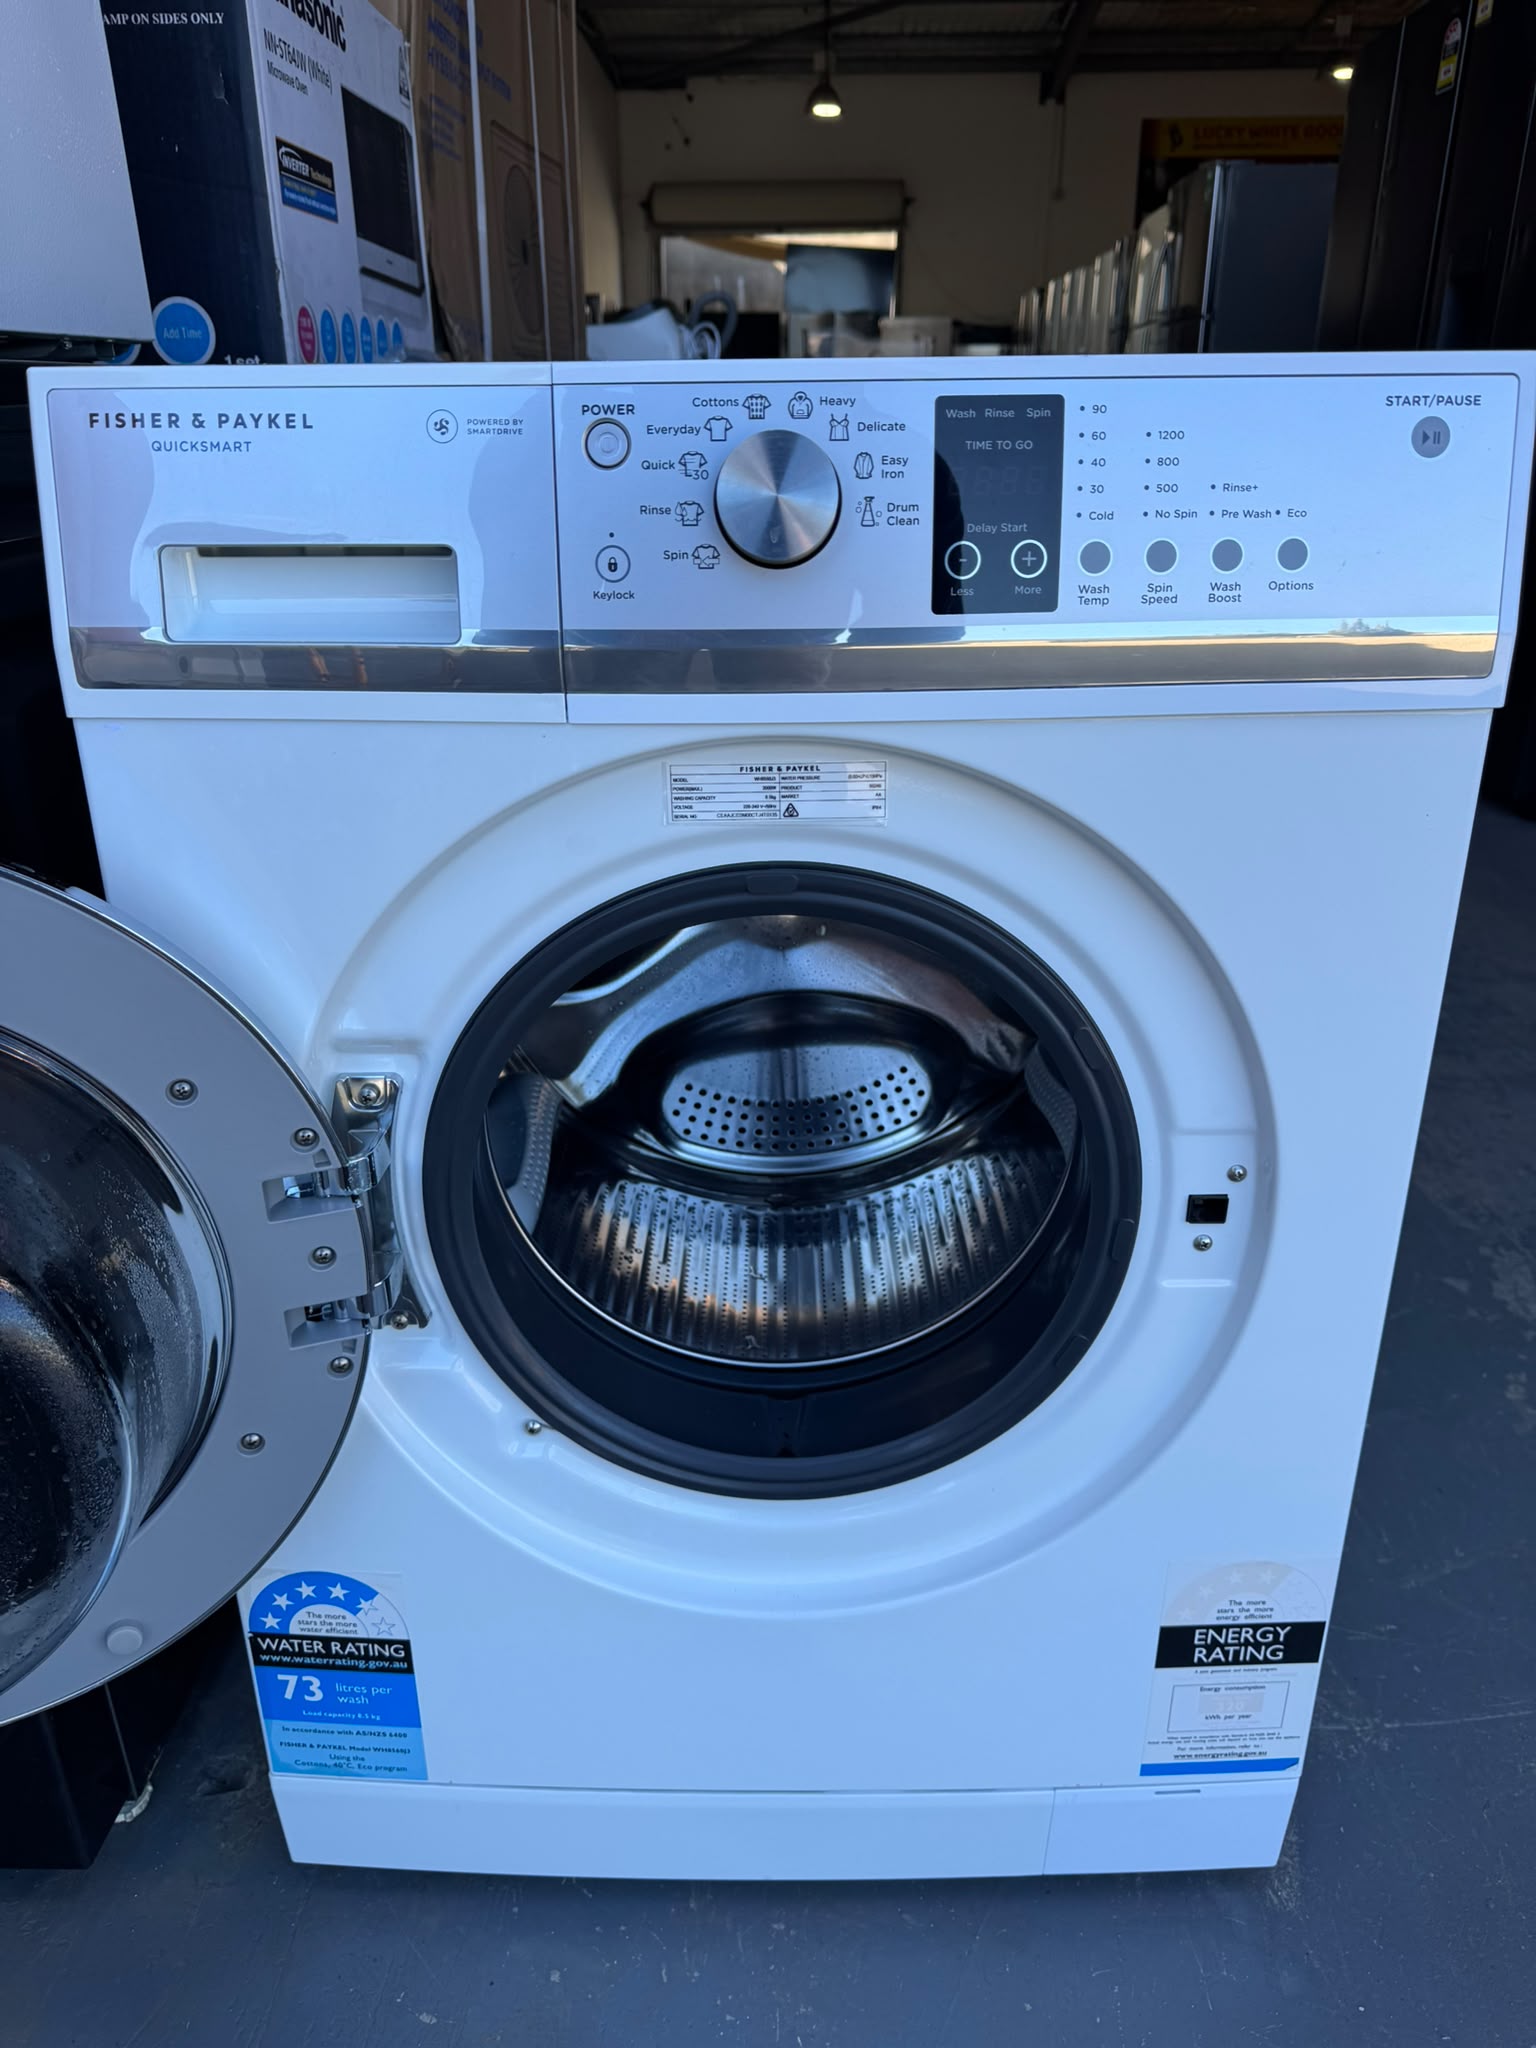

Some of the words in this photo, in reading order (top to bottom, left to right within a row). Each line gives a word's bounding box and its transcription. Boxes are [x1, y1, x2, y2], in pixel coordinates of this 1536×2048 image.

[131, 13, 149, 25] ON
[152, 12, 188, 25] SIDES
[190, 12, 224, 25] ONLY
[276, 0, 346, 53] asonic
[266, 59, 295, 89] Microwave
[295, 76, 309, 96] Oven
[307, 56, 333, 96] (White)
[1193, 123, 1248, 141] LUCKY
[282, 154, 310, 178] INVERTER
[163, 327, 180, 340] Add
[181, 327, 203, 340] Time
[692, 396, 740, 408] Cottons
[819, 395, 857, 409] Heavy
[1385, 394, 1482, 408] START/PAUSE
[581, 404, 635, 416] POWER
[945, 408, 976, 419] Wash
[984, 407, 1016, 418] Rinse
[1026, 407, 1052, 420] Spin
[1092, 404, 1108, 414] 90
[89, 412, 181, 429] FISHER
[191, 413, 206, 429] &
[217, 413, 314, 429] PAYKEL
[466, 418, 510, 426] POWERED
[512, 418, 524, 426] BY
[466, 427, 524, 436] SMARTDRIVE
[646, 423, 702, 437] Everyday
[857, 421, 907, 433] Delicate
[1091, 431, 1107, 441] 60
[1157, 430, 1186, 440] 1200
[151, 440, 252, 453] QUICKSMART
[965, 440, 994, 451] TIME
[996, 440, 1013, 450] TO
[1014, 440, 1034, 450] GO
[640, 459, 676, 472] Quick
[881, 454, 910, 468] Easy
[1091, 457, 1107, 468] 40
[1156, 456, 1180, 467] 800
[692, 469, 710, 481] 30
[881, 468, 905, 480] Iron
[1089, 484, 1105, 494] 30
[1156, 483, 1179, 493] 500
[1222, 482, 1260, 493] Rinse+
[639, 504, 672, 516] Rinse
[886, 501, 920, 513] Drum
[1287, 508, 1308, 518] Eco
[1088, 510, 1115, 521] Cold
[1155, 508, 1172, 519] No
[1173, 508, 1198, 521] Spin
[1221, 508, 1240, 519] Pre
[1242, 508, 1273, 519] Wash
[886, 515, 920, 527] Clean
[967, 522, 998, 534] Delay
[1000, 522, 1028, 533] Start
[663, 549, 689, 563] Spin
[950, 586, 975, 597] Less
[1014, 585, 1043, 596] More
[1077, 584, 1111, 595] Wash
[1147, 582, 1173, 594] Spin
[1209, 581, 1242, 592] Wash
[1268, 580, 1315, 592] Options
[592, 590, 636, 602] Keylock
[1077, 596, 1110, 608] Temp
[1140, 594, 1179, 607] Speed
[1208, 592, 1242, 604] Boost
[305, 1611, 322, 1619] The
[299, 1626, 323, 1634] water
[325, 1627, 358, 1635] efficient
[1193, 1625, 1292, 1645] ENERGY
[257, 1637, 326, 1654] WATER
[331, 1641, 405, 1658] RATING
[1193, 1644, 1285, 1664] RATING
[259, 1653, 408, 1669] www.waterrating.gov.au
[276, 1673, 324, 1702] 73
[335, 1682, 368, 1694] litres
[371, 1686, 393, 1697] per
[1224, 1684, 1266, 1692] consumption
[337, 1695, 369, 1705] wash
[324, 1711, 356, 1720] capacity
[371, 1713, 381, 1721] kg
[1237, 1713, 1253, 1721] year
[291, 1727, 335, 1735] accordance
[279, 1741, 307, 1749] FISHER
[316, 1743, 348, 1751] PAYKEL
[349, 1745, 371, 1753] Model
[328, 1753, 351, 1762] Using
[352, 1754, 366, 1762] the
[1173, 1750, 1268, 1761] www.energyrating.gov.au
[357, 1763, 373, 1771] Eco
[374, 1764, 408, 1773] program
